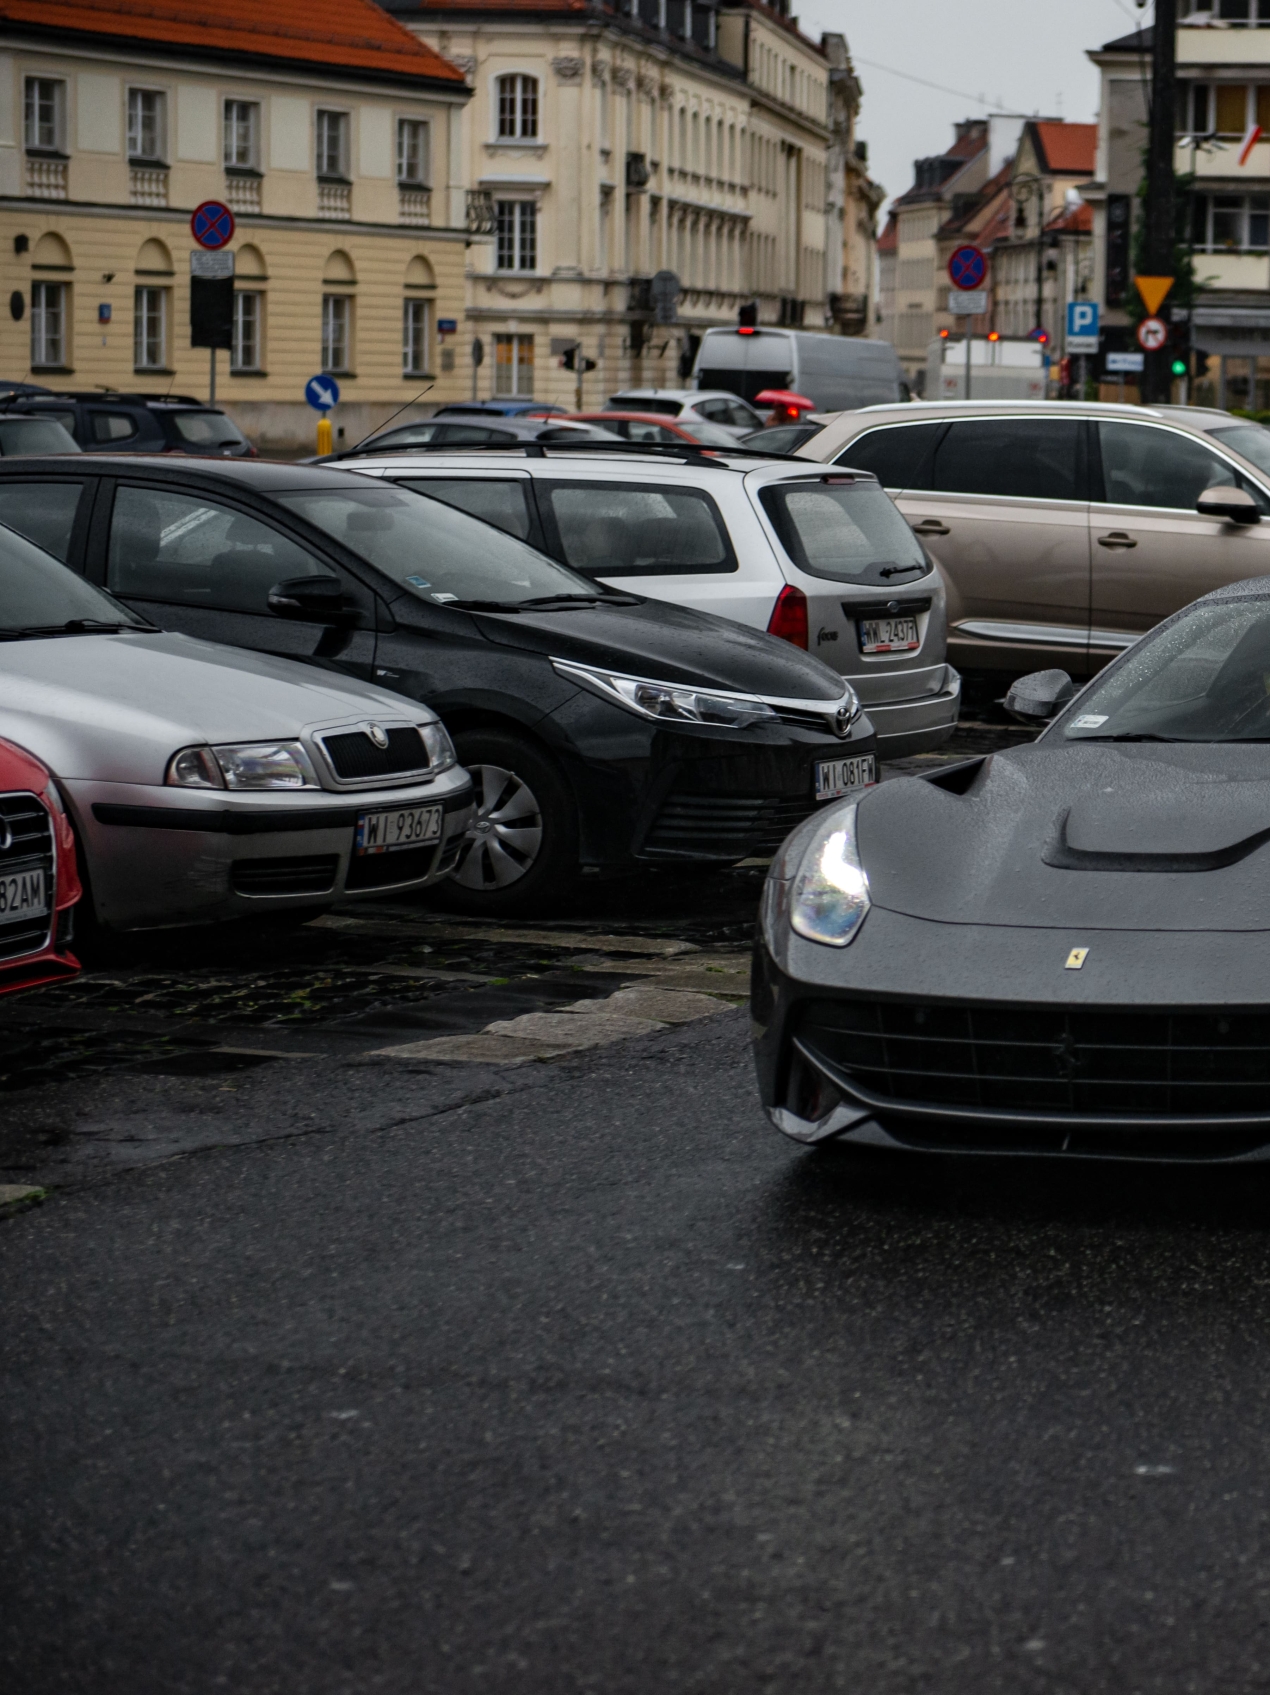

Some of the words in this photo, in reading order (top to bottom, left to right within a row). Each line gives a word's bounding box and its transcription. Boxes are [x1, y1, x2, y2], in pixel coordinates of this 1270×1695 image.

[1073, 305, 1094, 333] P
[821, 764, 837, 790] WI
[841, 757, 875, 786] 081FW
[367, 815, 390, 845] WI
[396, 808, 441, 841] 93673
